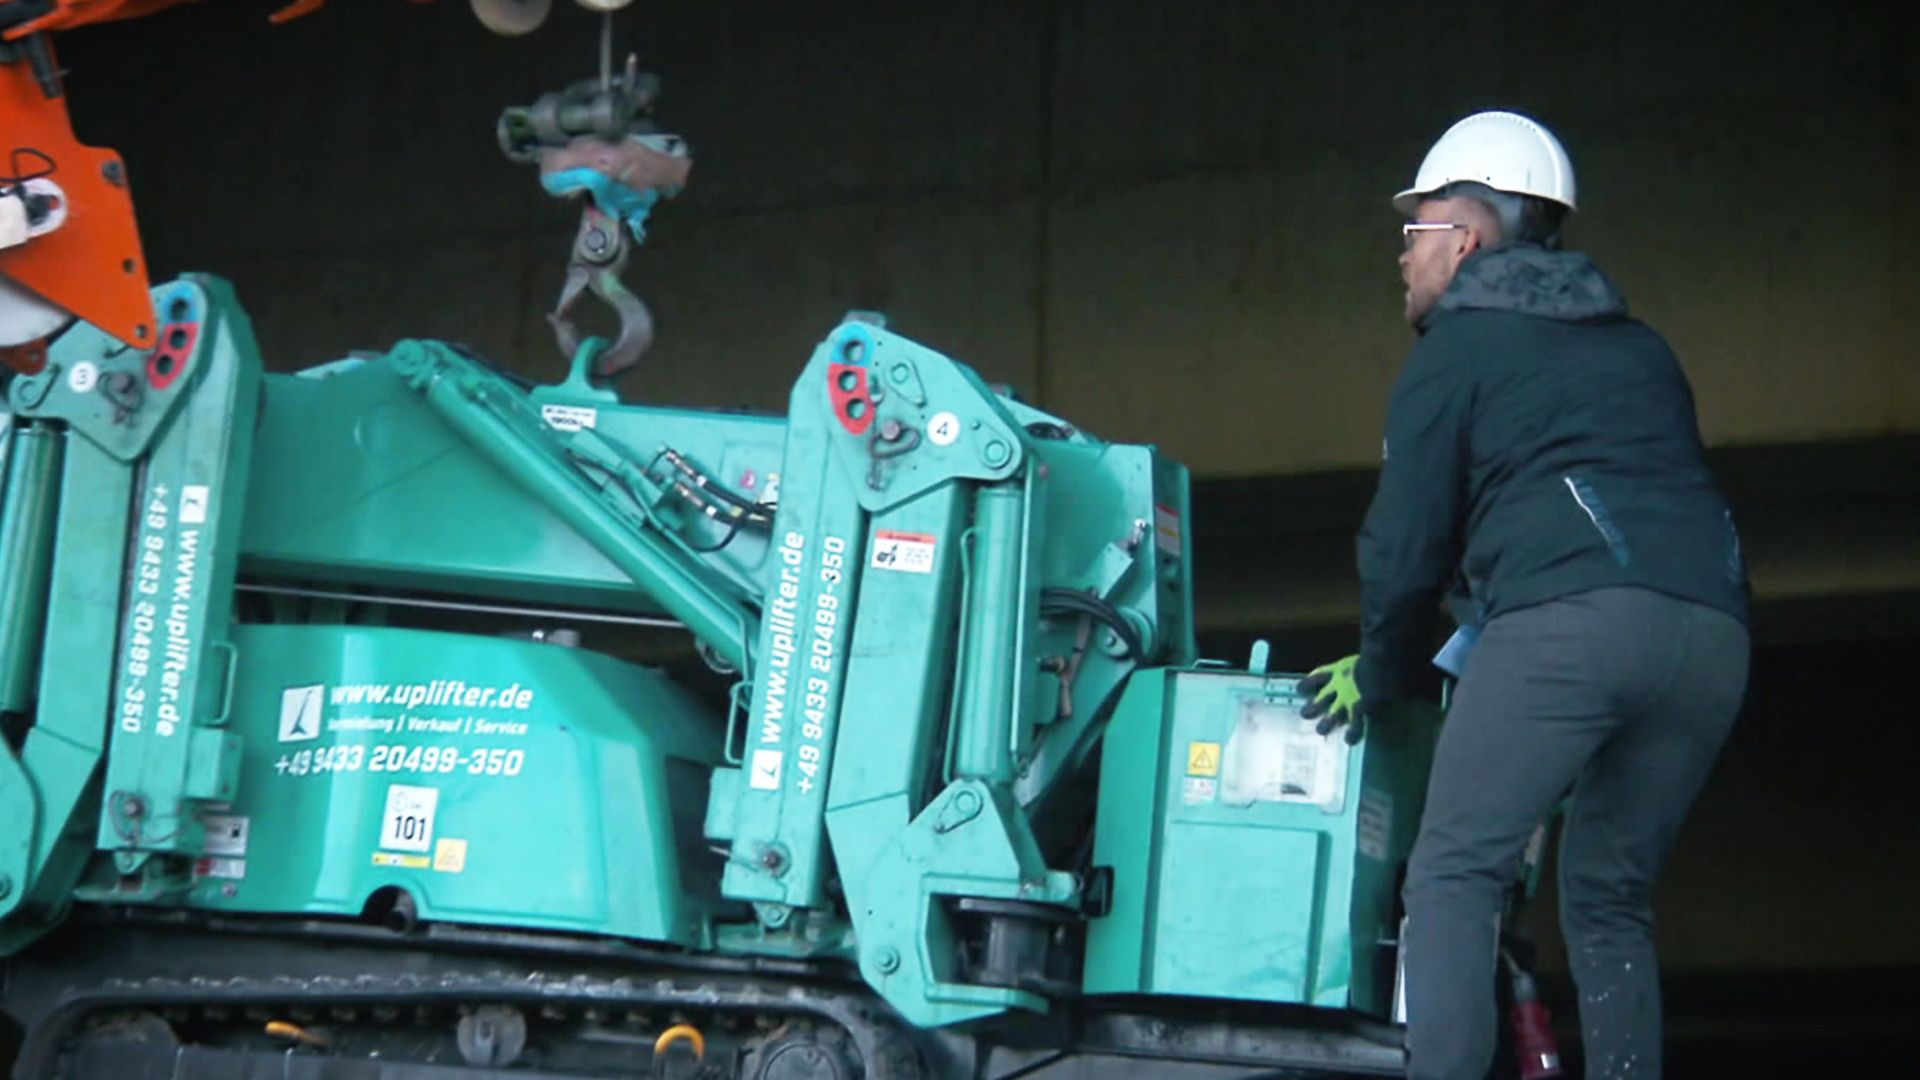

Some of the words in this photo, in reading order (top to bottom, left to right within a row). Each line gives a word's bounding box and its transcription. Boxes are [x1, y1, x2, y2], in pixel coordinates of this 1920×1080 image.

[75, 368, 88, 385] 3
[935, 421, 948, 435] 4
[147, 483, 168, 529] +49
[139, 535, 164, 595] 9433
[811, 536, 845, 672] 20499-350
[156, 530, 199, 736] www.uplifter.de
[760, 532, 804, 743] www.uplifter.de
[122, 601, 155, 733] 20499-350
[330, 680, 533, 709] www.uplifter.de
[803, 677, 828, 740] 9433
[408, 717, 462, 733] Verkauf
[474, 718, 528, 735] Service
[274, 749, 312, 777] +49
[313, 744, 365, 774] 9433
[367, 745, 526, 777] 20499-350
[797, 745, 821, 795] +49
[394, 815, 426, 842] 101
